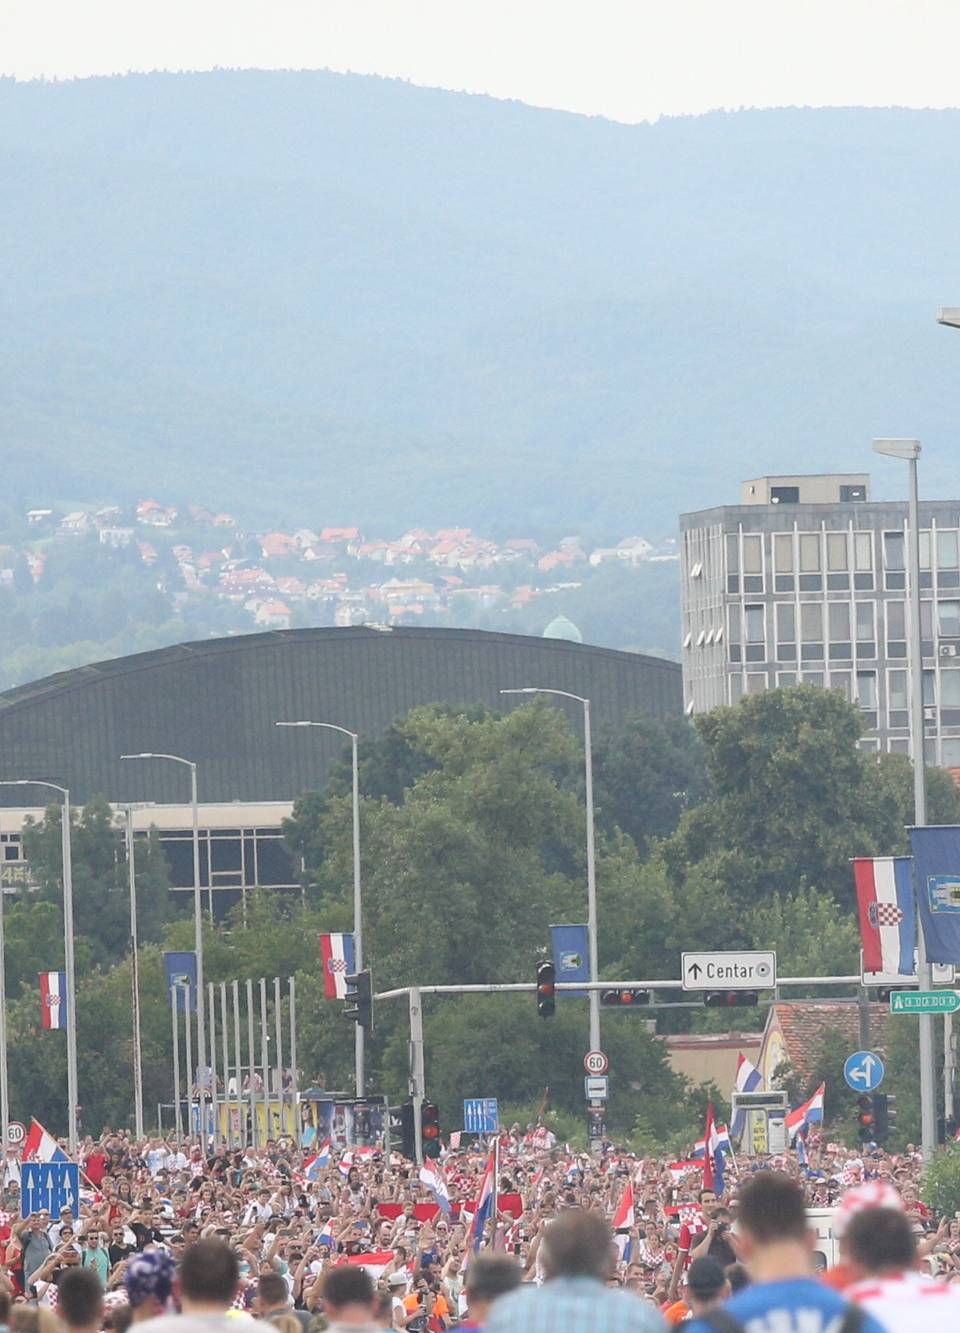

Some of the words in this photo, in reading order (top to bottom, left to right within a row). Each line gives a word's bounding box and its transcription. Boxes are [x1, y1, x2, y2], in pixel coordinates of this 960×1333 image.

[706, 962, 754, 979] Centar
[589, 1056, 603, 1069] 60
[8, 1128, 21, 1140] 60
